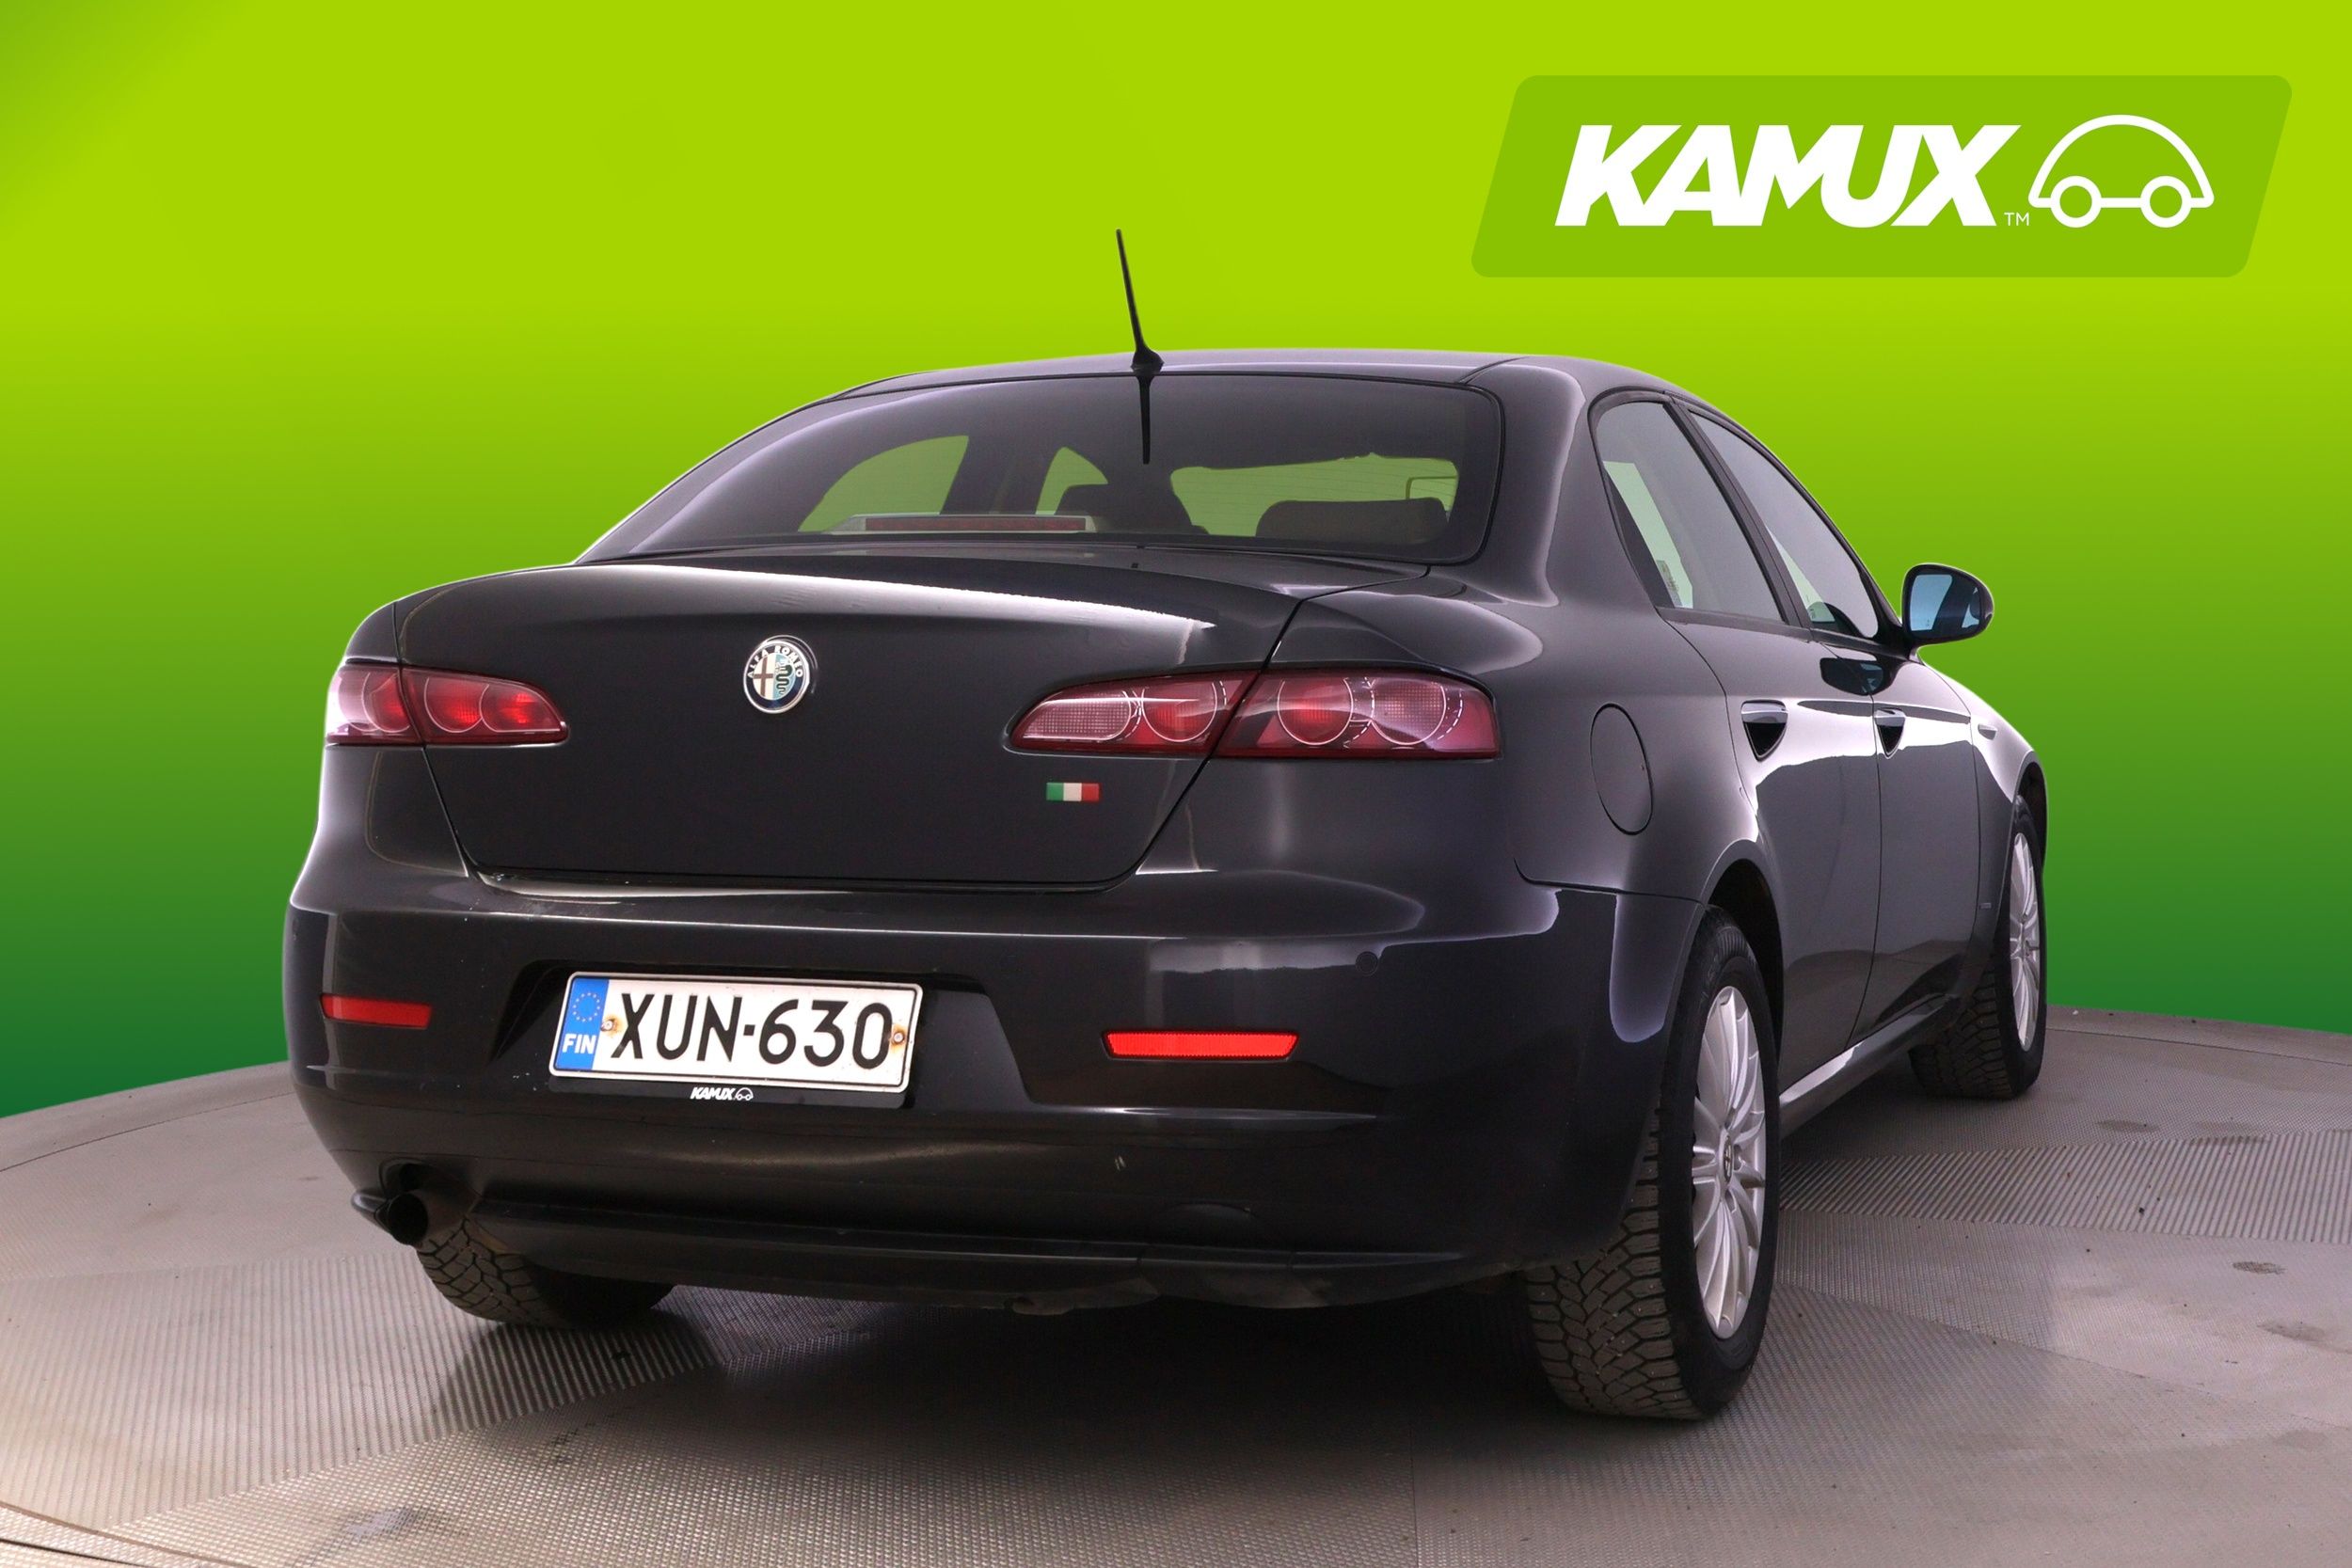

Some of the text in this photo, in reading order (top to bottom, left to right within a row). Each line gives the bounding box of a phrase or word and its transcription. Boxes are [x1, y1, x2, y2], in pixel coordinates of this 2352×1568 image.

[747, 645, 803, 678] ALFA ROMEO
[563, 1033, 596, 1053] FIN
[612, 992, 893, 1069] XUN-630
[691, 1087, 736, 1101] KAMUX
